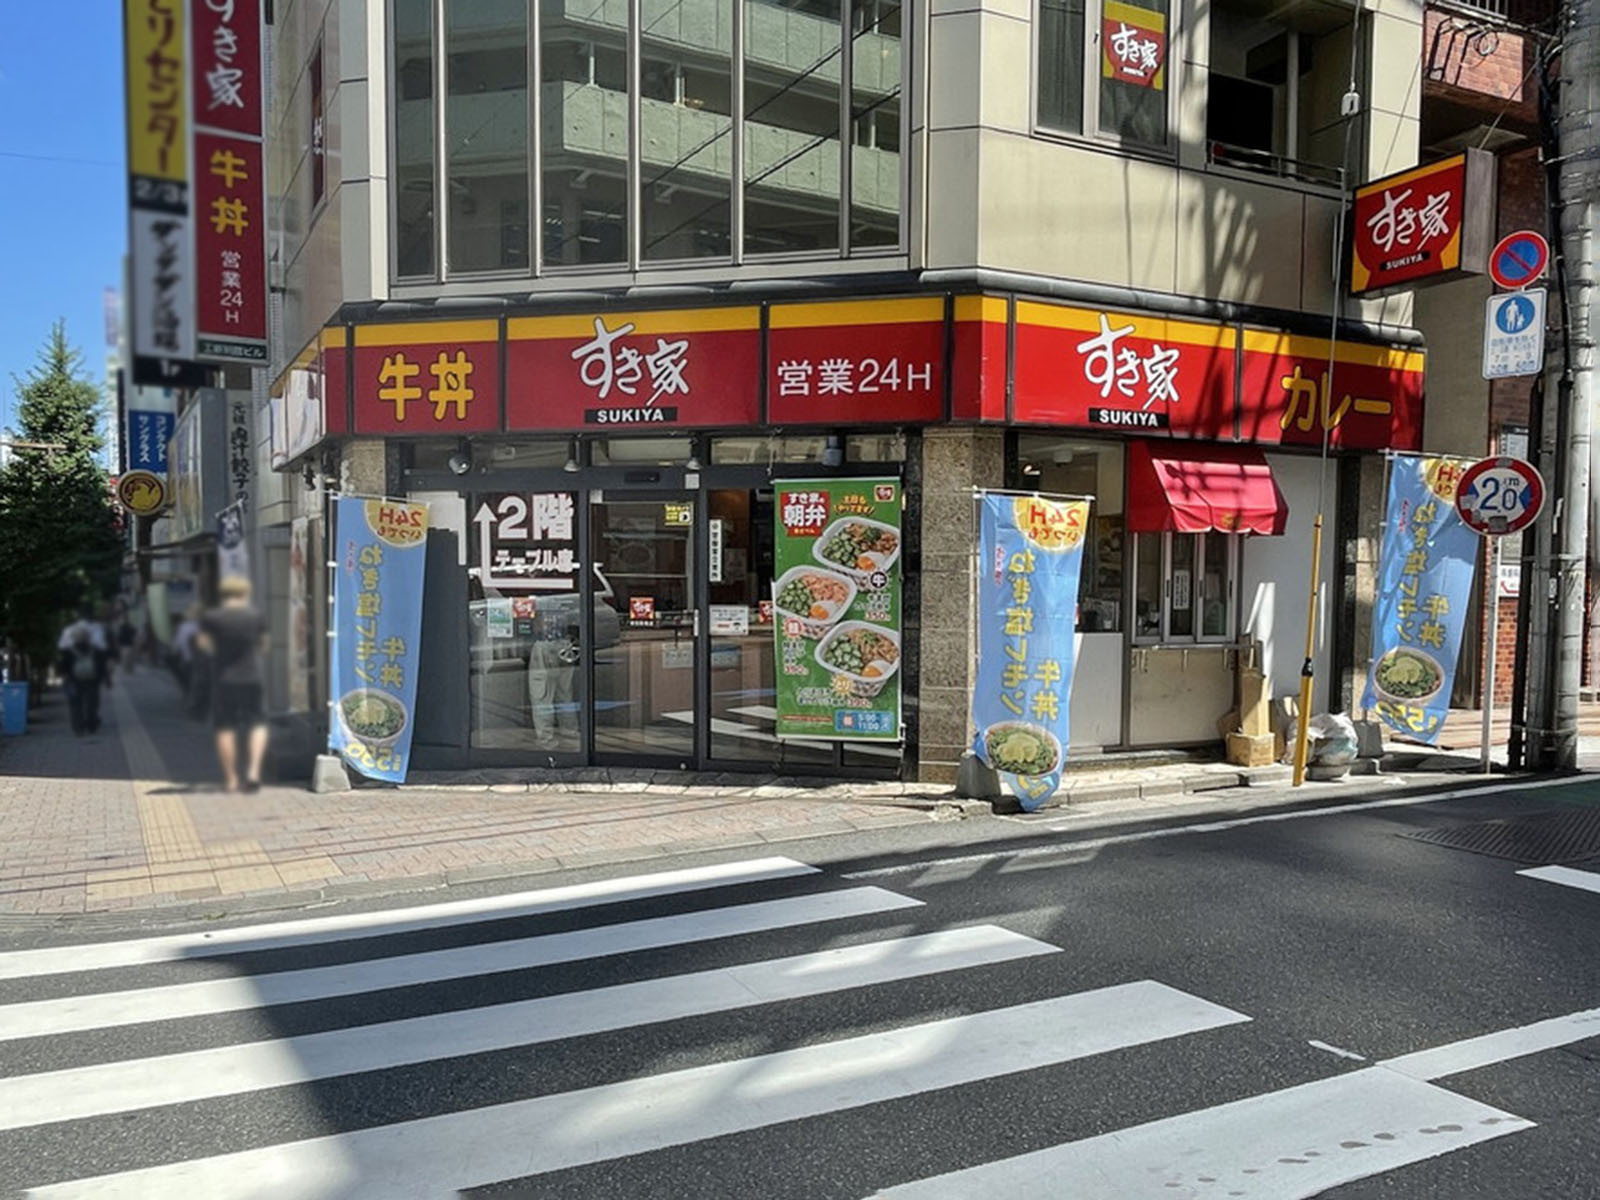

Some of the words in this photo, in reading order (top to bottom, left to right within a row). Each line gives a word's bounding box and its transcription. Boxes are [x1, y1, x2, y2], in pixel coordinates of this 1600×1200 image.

[1110, 22, 1158, 70] すき家
[210, 151, 249, 236] 牛丼
[1367, 189, 1451, 252] すき家
[1386, 254, 1424, 270] SUKIYA
[220, 251, 243, 323] 営業24H
[379, 350, 474, 421] 牛丼
[571, 317, 690, 406] すき家
[777, 358, 932, 396] 営業24H
[1077, 314, 1180, 410] すき家
[597, 409, 664, 423] SUKIYA
[1100, 409, 1158, 427] SUKIYA
[1281, 365, 1391, 432] カレー
[498, 493, 574, 540] 2階
[784, 504, 826, 527] 朝弁
[872, 573, 886, 587] 牛
